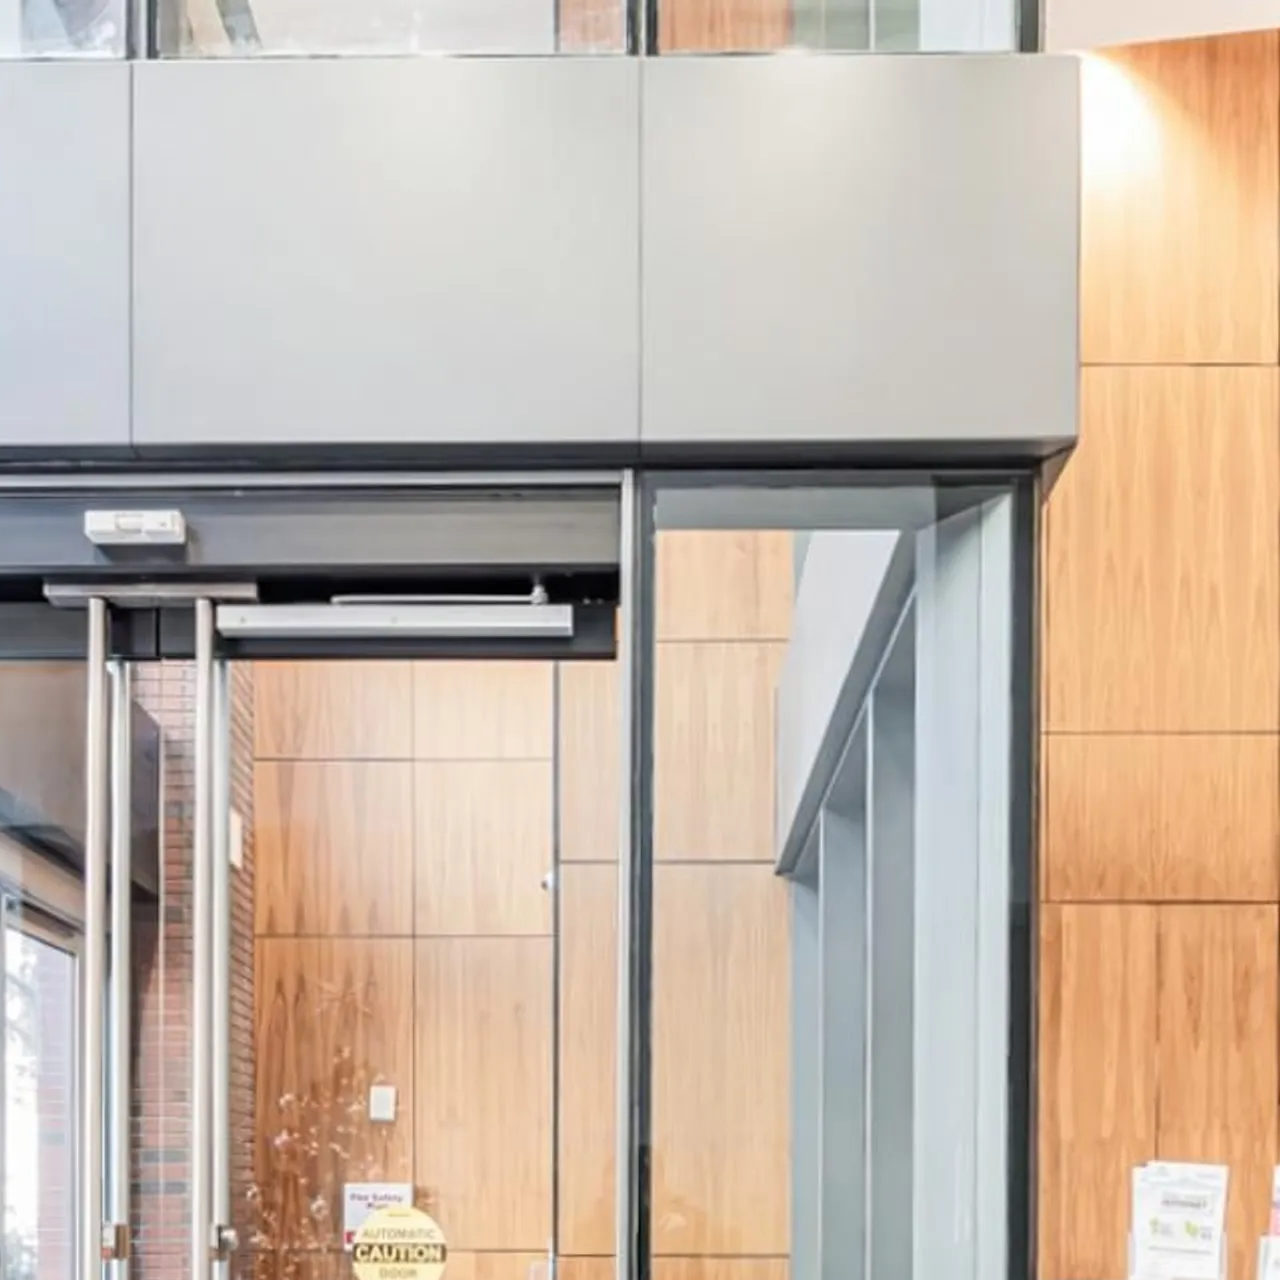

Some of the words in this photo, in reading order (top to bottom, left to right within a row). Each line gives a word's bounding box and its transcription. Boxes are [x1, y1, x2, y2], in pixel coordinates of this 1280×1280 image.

[362, 1228, 436, 1240] AUTOMATIC
[355, 1245, 442, 1262] CAUTION
[379, 1267, 417, 1279] DOOR
